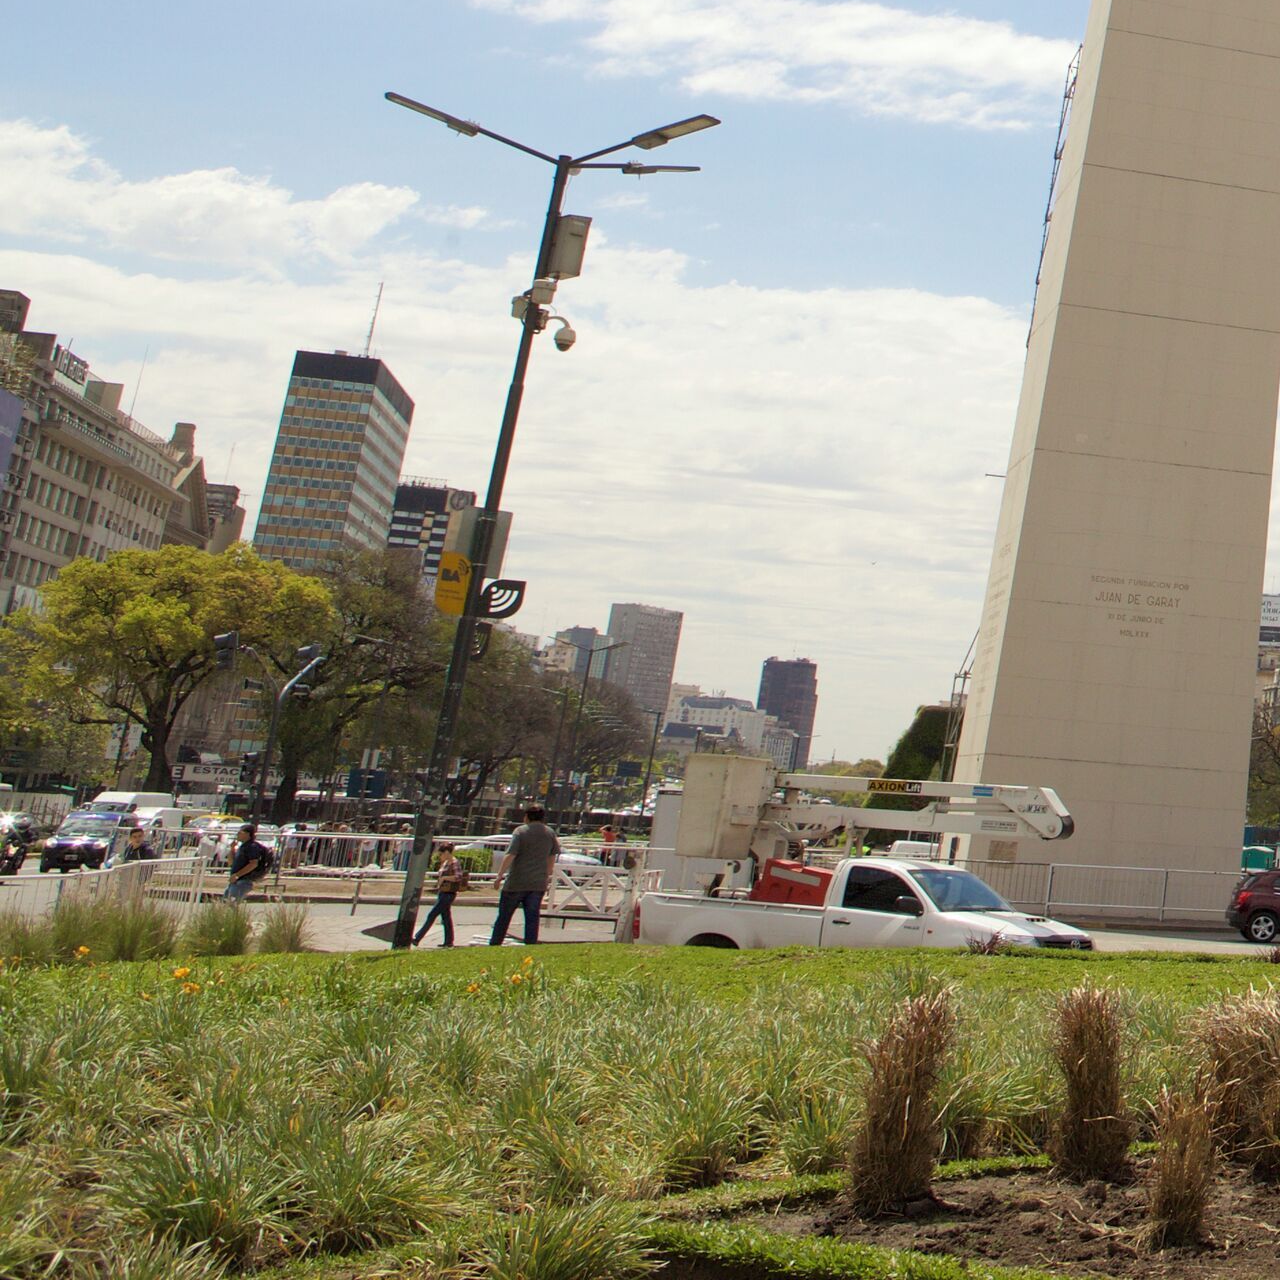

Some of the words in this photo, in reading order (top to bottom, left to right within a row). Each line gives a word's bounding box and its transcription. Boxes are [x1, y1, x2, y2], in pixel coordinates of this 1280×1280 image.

[1095, 592, 1122, 603] JUAN
[1127, 593, 1141, 605] DE
[1146, 595, 1182, 608] GARAY
[868, 780, 905, 792] AXION
[905, 782, 922, 793] Lift
